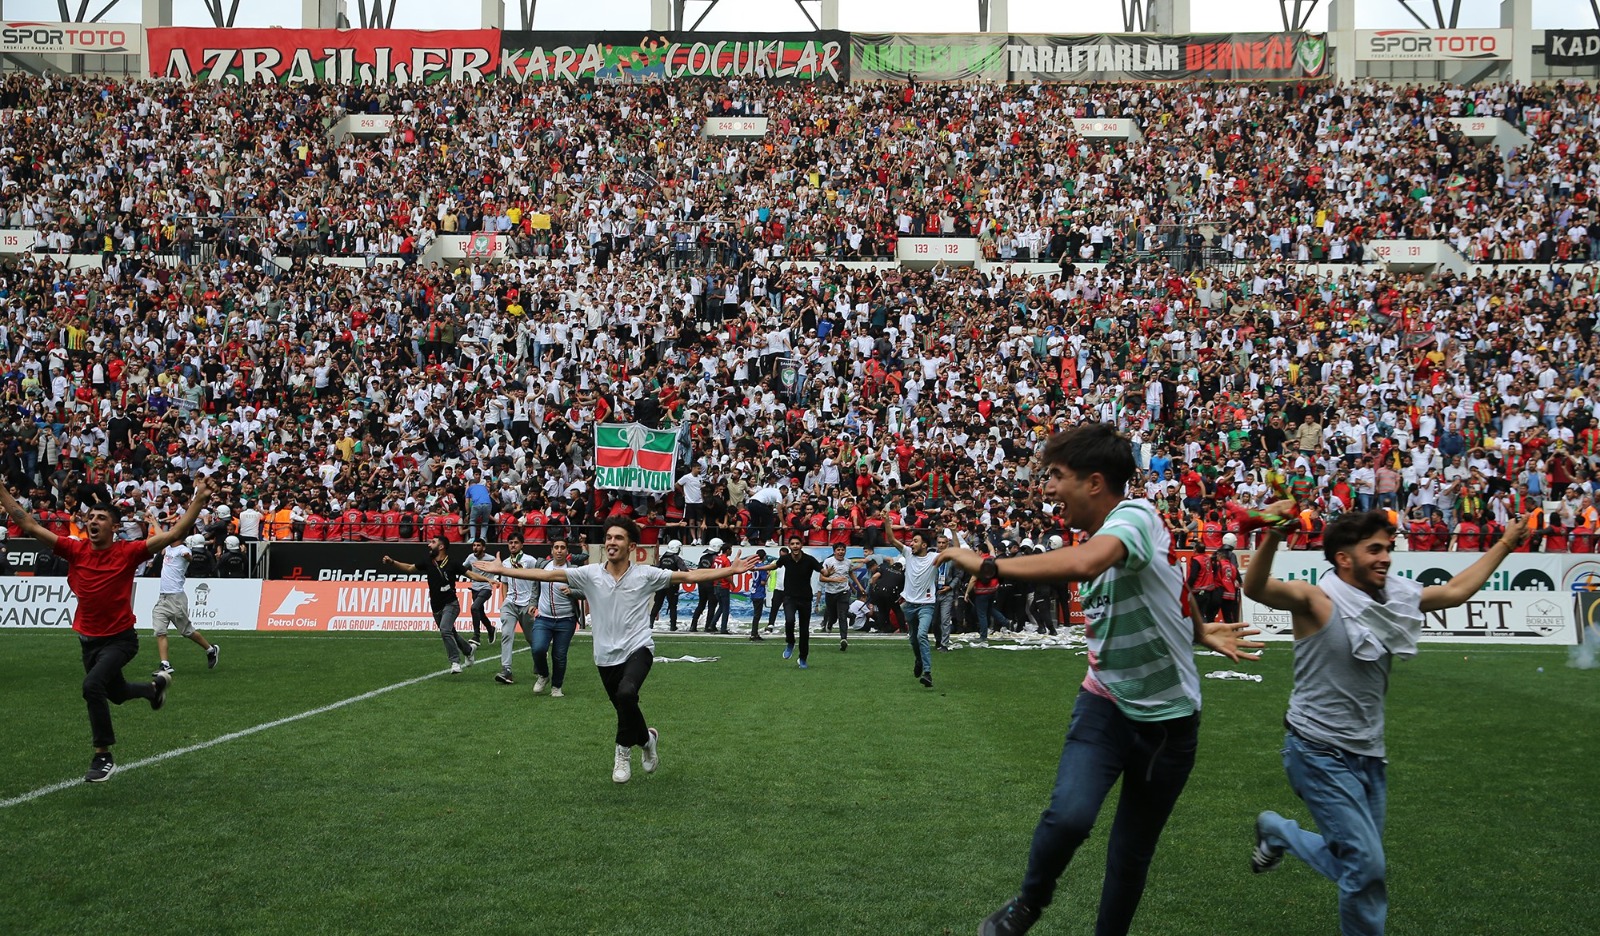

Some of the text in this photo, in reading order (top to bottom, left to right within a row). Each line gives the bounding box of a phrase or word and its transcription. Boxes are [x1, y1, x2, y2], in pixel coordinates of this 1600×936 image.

[2, 29, 125, 45] SPOR TOTO
[1371, 37, 1496, 52] SPOR TOTO
[1552, 35, 1600, 56] KAD
[861, 35, 1294, 73] AMEDSPOR TARAFTARLAR DERNEĞİ
[501, 44, 604, 84] KARA
[361, 119, 374, 127] 243
[719, 122, 755, 130] 242 241
[1081, 123, 1117, 131] 241 240
[1472, 122, 1485, 130] 239
[4, 236, 18, 246] 135
[914, 244, 959, 254] 133 132
[1408, 246, 1421, 256] 131
[1465, 601, 1513, 630] ET
[267, 618, 317, 628] Petrol Ofisi
[332, 619, 347, 630] AVA
[349, 619, 375, 630] GROUP
[381, 620, 430, 631] AMEDSPOR'A
[1526, 617, 1554, 625] BORAN
